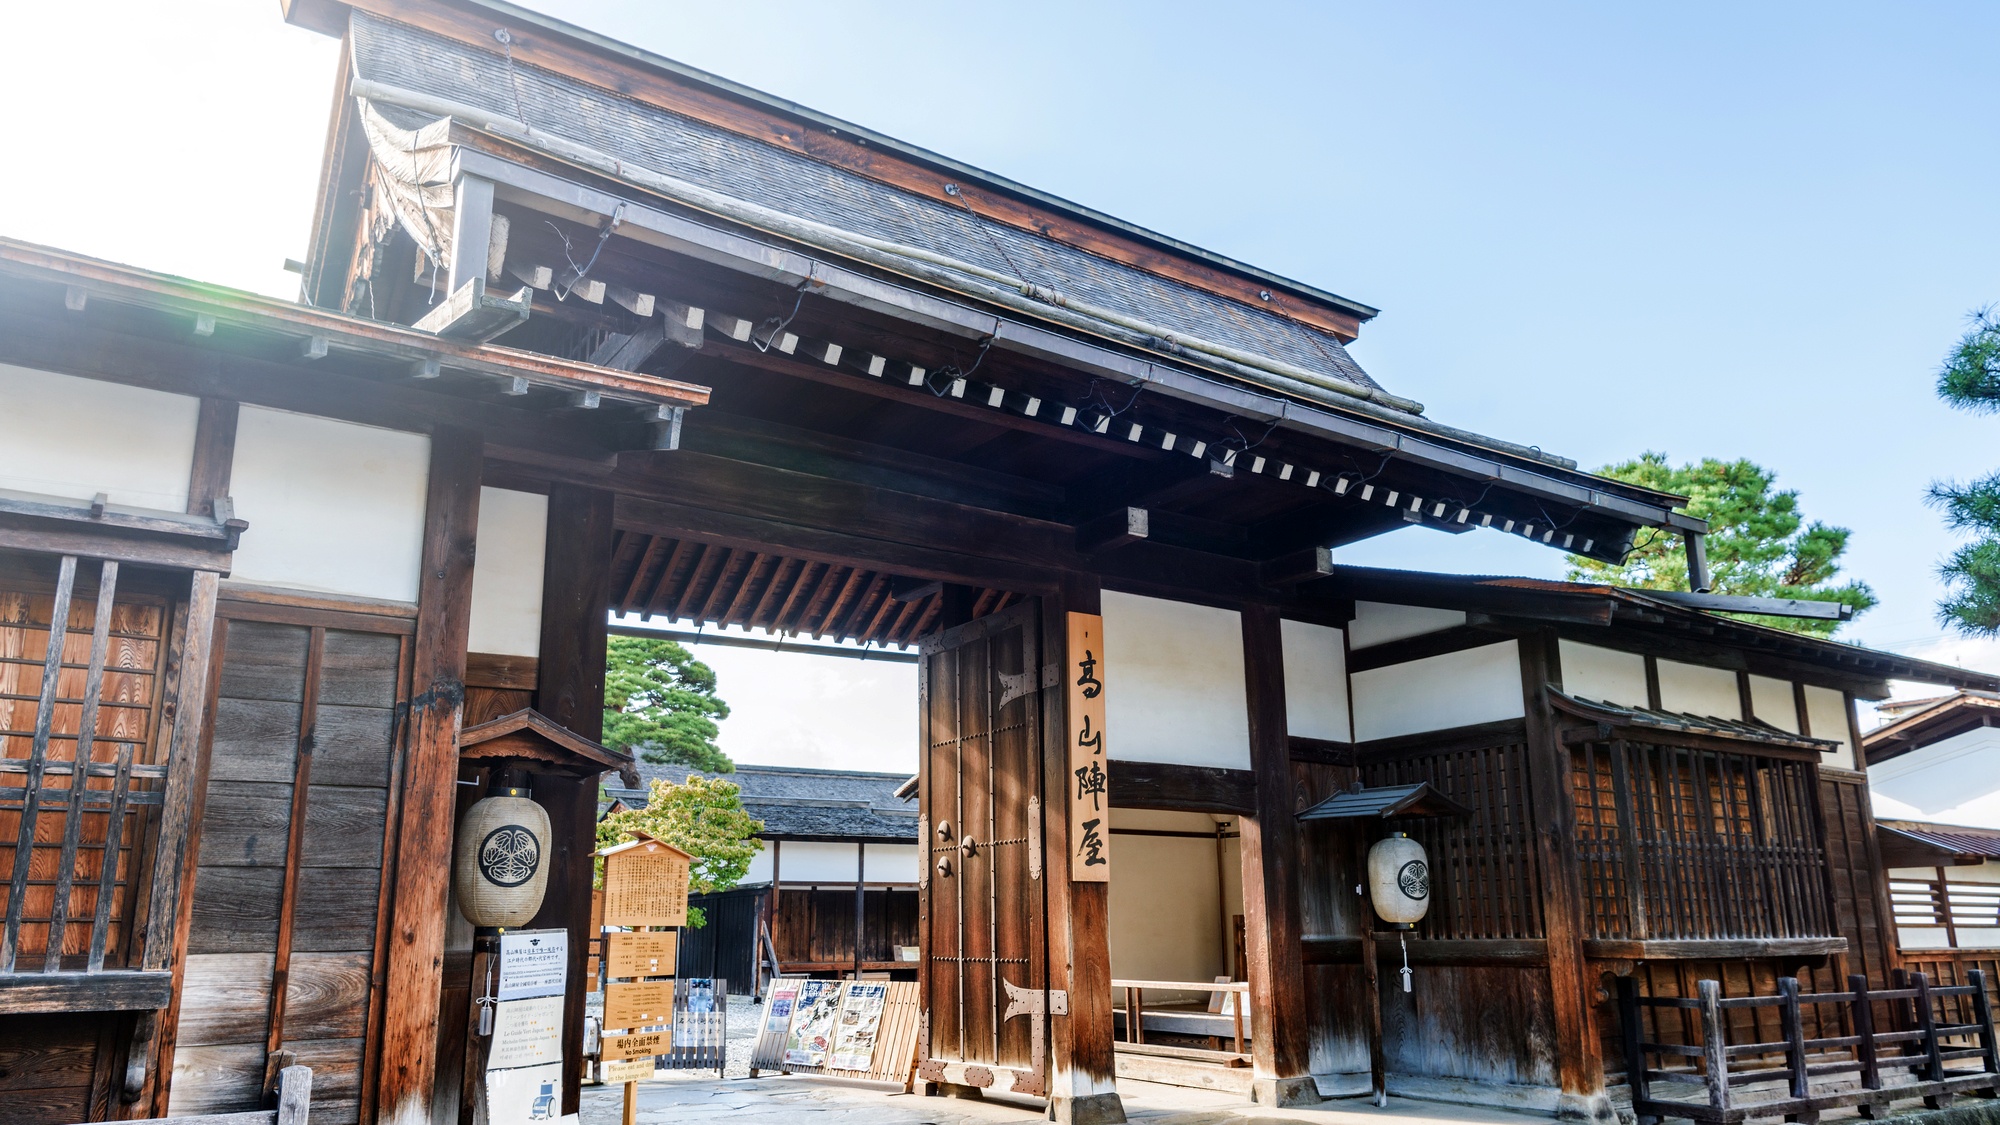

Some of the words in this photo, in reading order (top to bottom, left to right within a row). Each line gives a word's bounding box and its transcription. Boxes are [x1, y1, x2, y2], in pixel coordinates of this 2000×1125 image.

[1074, 650, 1107, 867] 高山陣屋
[616, 1034, 661, 1049] 場内全面禁煙
[608, 1064, 626, 1072] Please
[615, 1073, 624, 1081] the
